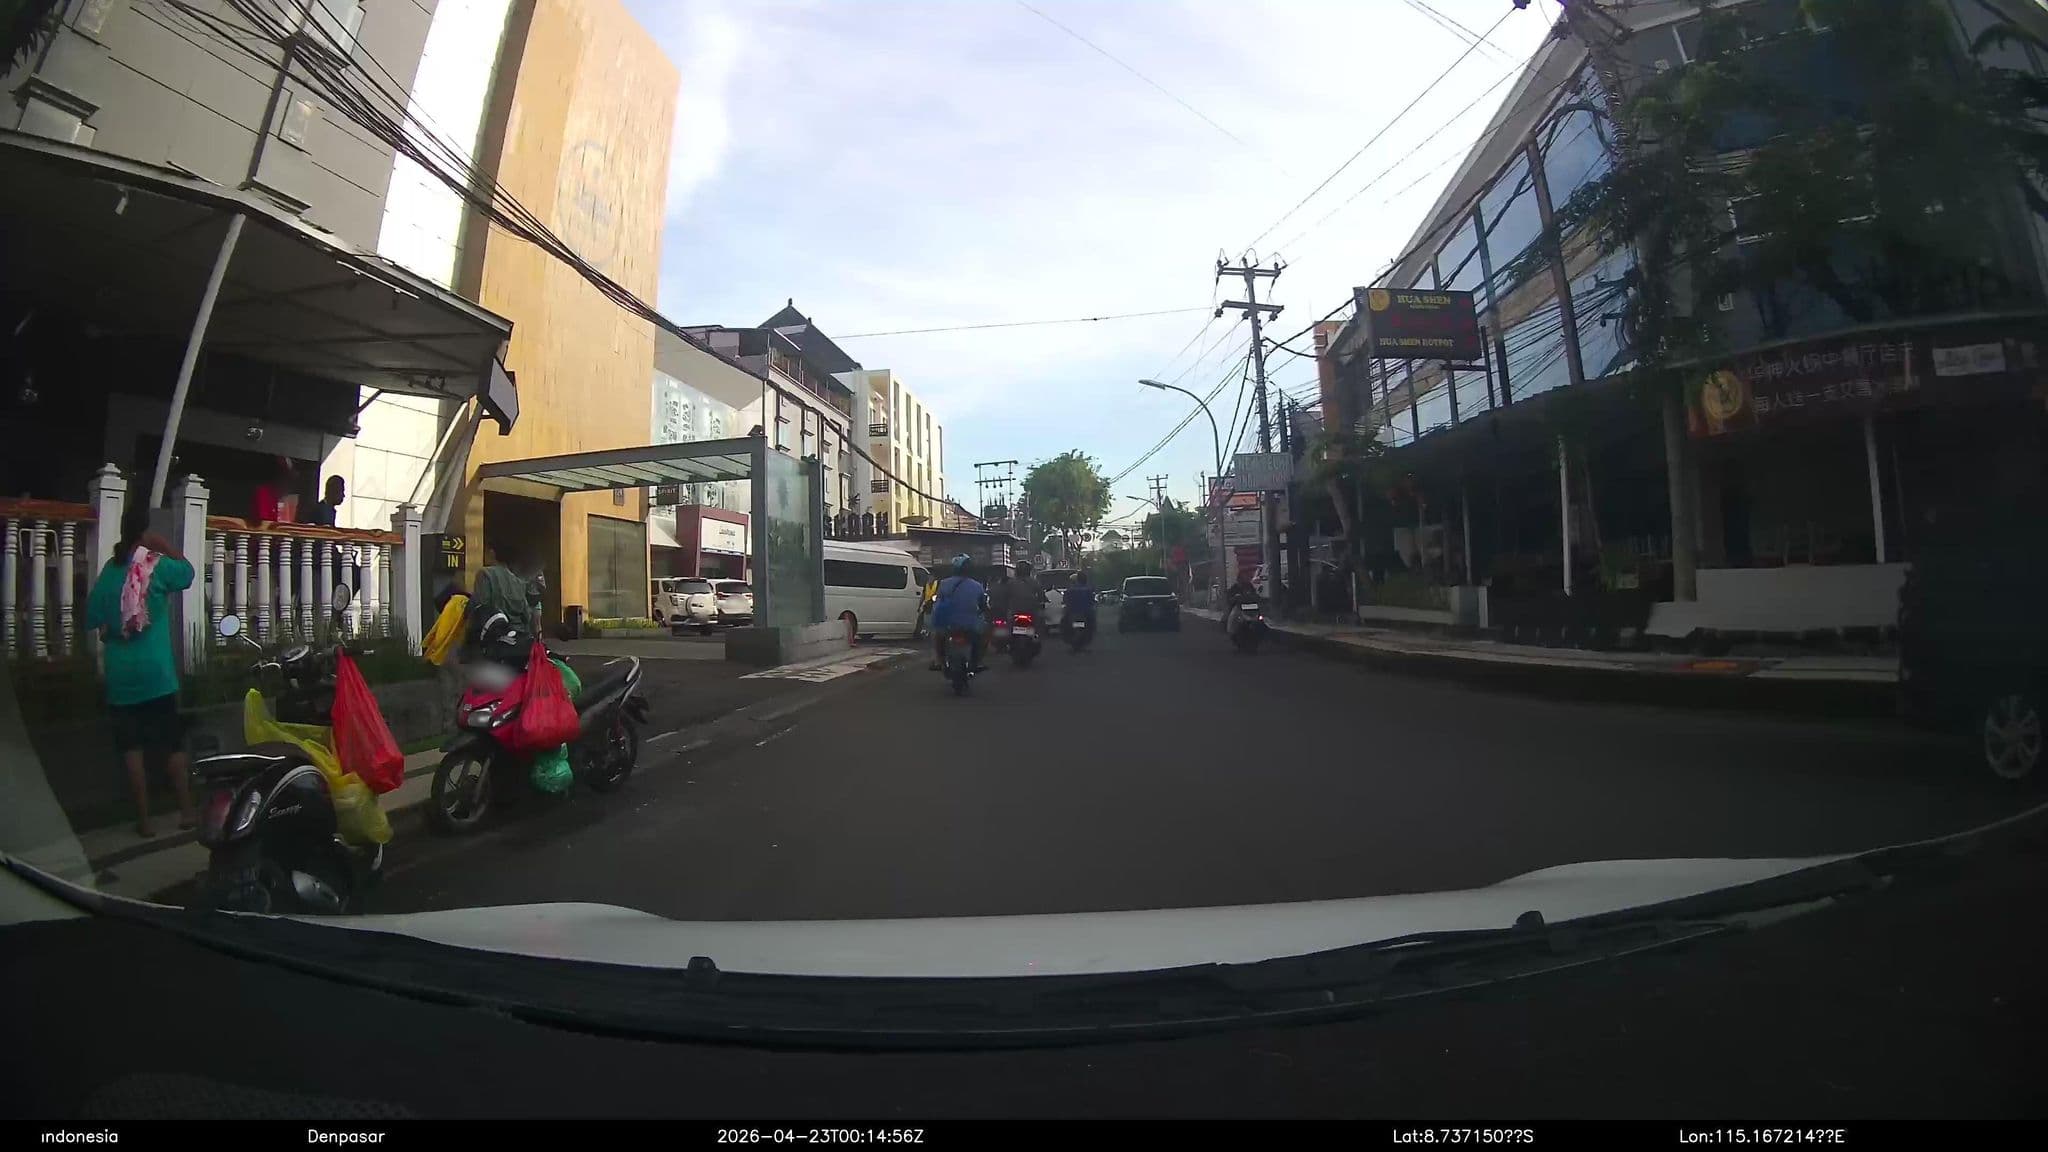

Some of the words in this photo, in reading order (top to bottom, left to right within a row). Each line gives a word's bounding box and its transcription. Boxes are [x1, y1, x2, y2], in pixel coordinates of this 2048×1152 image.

[1397, 295, 1422, 304] HUA
[1422, 295, 1451, 305] SHEN
[447, 554, 459, 568] IN
